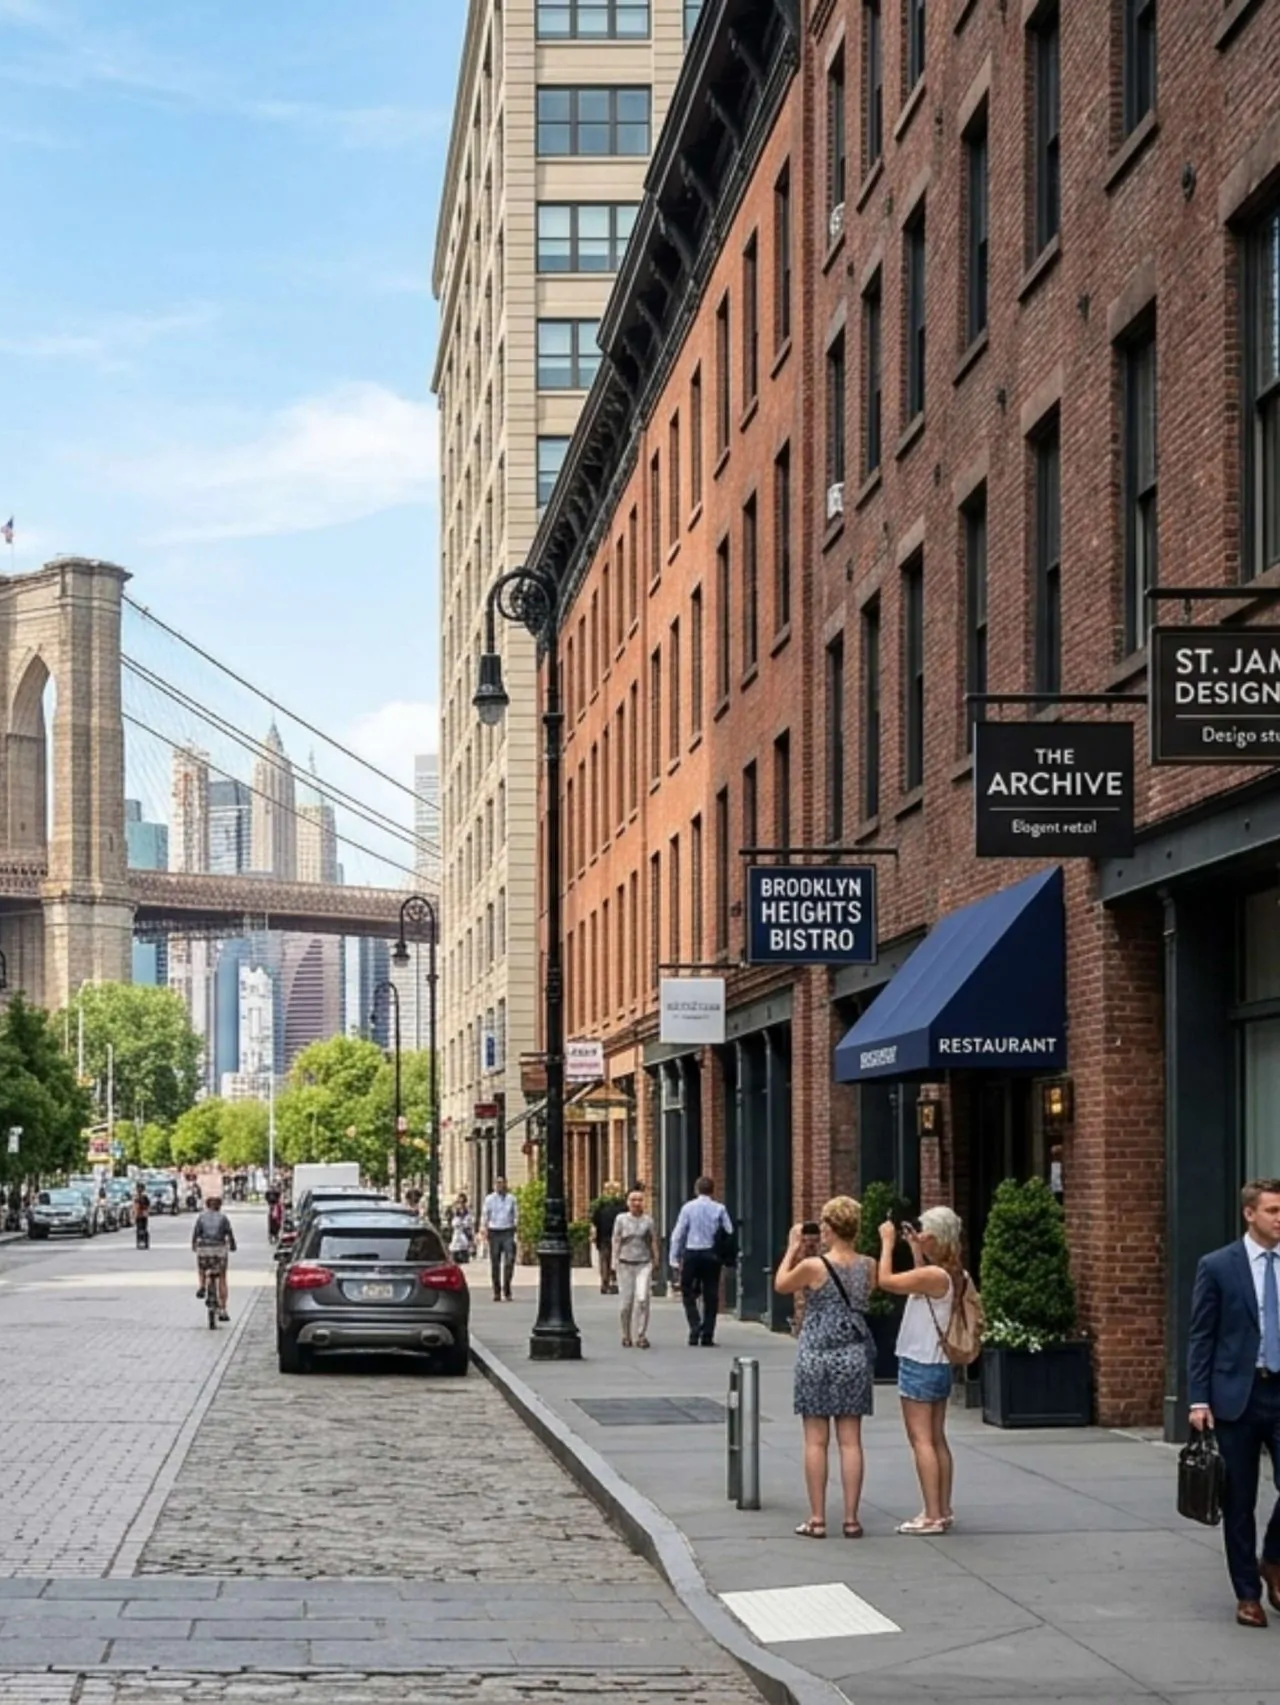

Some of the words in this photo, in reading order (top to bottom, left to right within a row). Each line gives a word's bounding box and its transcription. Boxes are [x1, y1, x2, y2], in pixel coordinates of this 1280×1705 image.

[1175, 648, 1219, 674] ST.
[1035, 748, 1075, 764] THE
[986, 772, 1123, 796] ARCHIVE
[761, 878, 861, 897] BROOKLYN
[761, 901, 862, 924] HEIGHTS
[770, 929, 854, 951] BISTRO
[938, 1037, 1057, 1054] RESTAURANT
